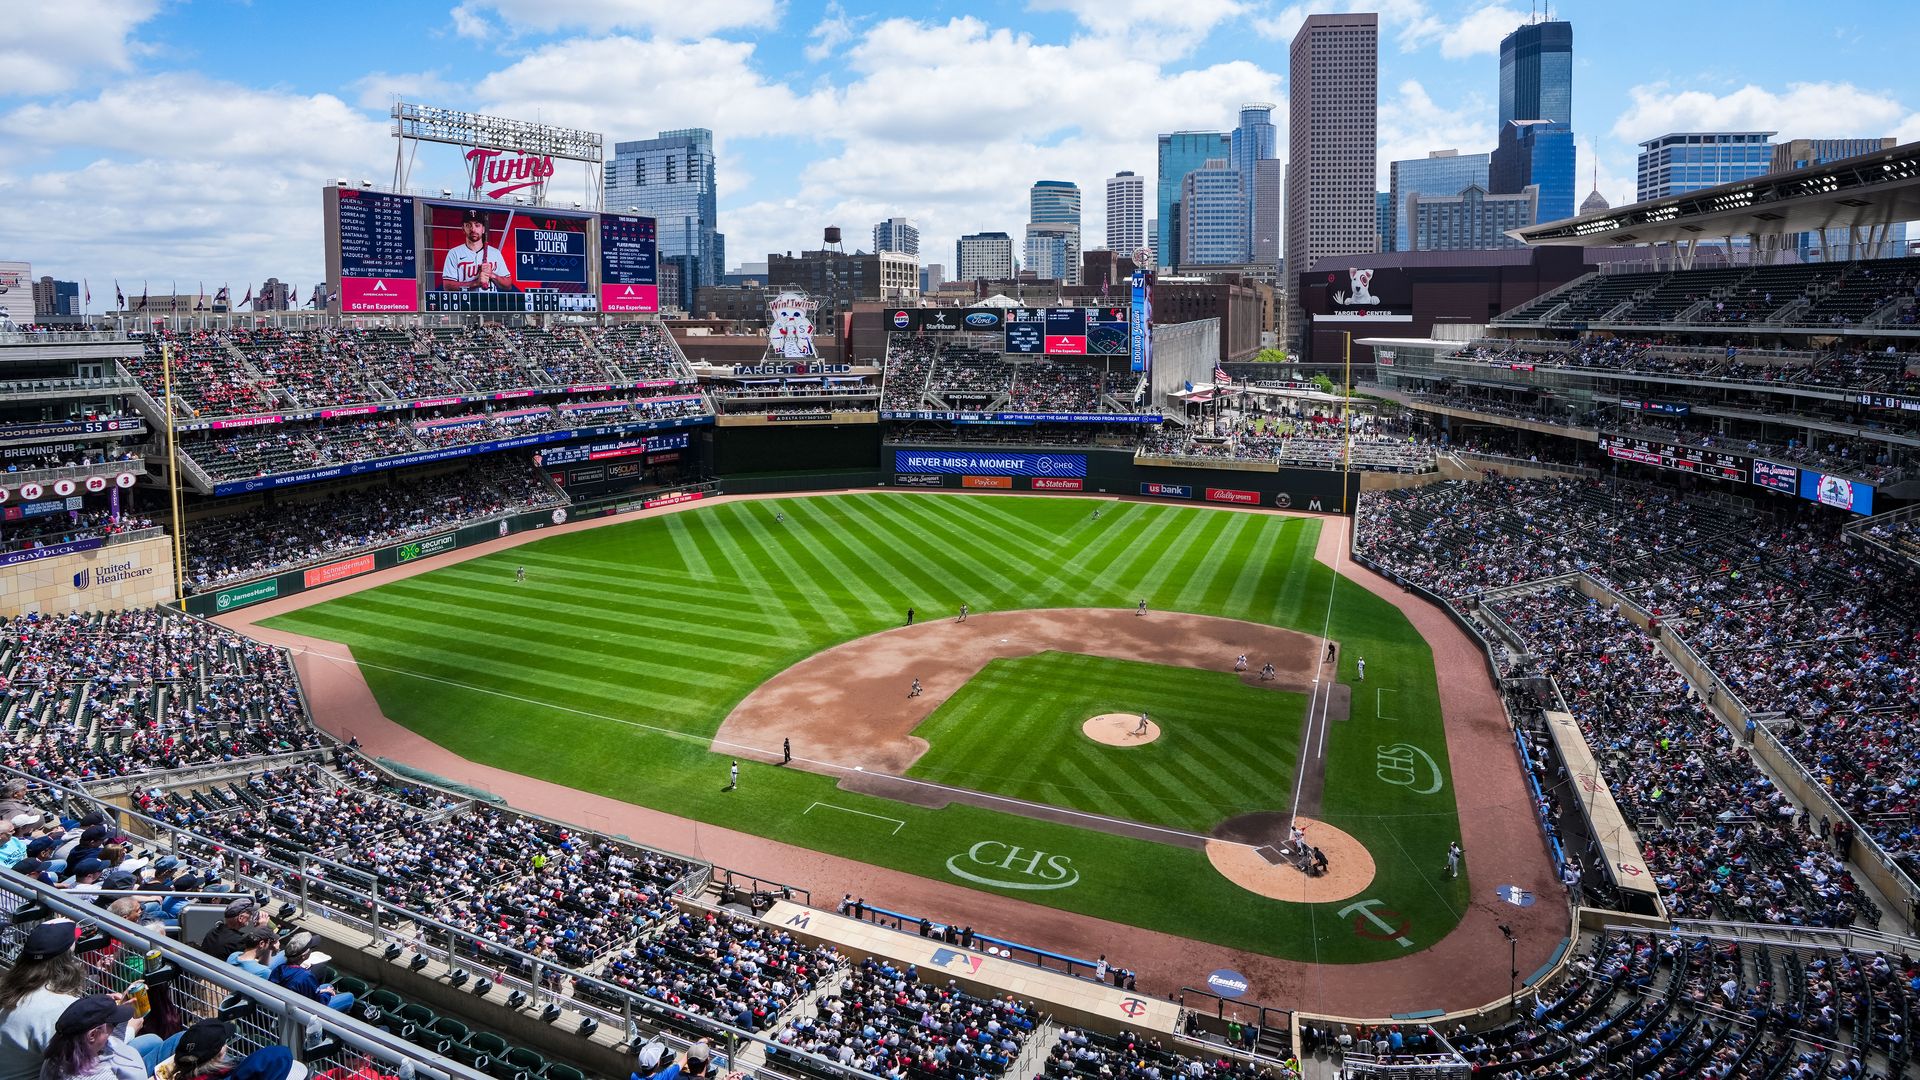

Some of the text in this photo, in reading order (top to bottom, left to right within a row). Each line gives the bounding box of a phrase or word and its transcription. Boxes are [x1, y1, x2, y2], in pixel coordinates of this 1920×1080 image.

[466, 149, 554, 189] Twins
[545, 220, 556, 230] 47
[534, 232, 568, 241] EDOUARD
[535, 241, 567, 253] JULIEN
[522, 254, 534, 264] 0-1
[1132, 278, 1143, 287] 47
[770, 299, 818, 310] Win! Twins!
[736, 364, 851, 374] TARGET FIELD
[221, 419, 252, 428] Treasure
[4, 443, 74, 458] BREWING PUB
[1632, 451, 1644, 460] Home
[1645, 454, 1658, 462] Games
[908, 458, 1025, 468] NEVER MISS A MOMENT
[317, 469, 340, 478] MOMENT
[618, 464, 638, 474] SOLAR
[1755, 463, 1794, 476] Sota Summers
[90, 480, 102, 488] 29
[26, 488, 37, 496] 14
[1214, 490, 1235, 501] Bally
[422, 537, 452, 549] securian
[8, 546, 74, 562] GRAY DUCK
[422, 545, 444, 553] FINANCIAL
[96, 561, 131, 576] United
[323, 559, 370, 575] Schneiderman's
[96, 568, 152, 585] Healthcare
[232, 586, 275, 601] JamesHardie
[1376, 744, 1416, 786] CHS
[969, 840, 1072, 880] CHS
[786, 914, 810, 929] M
[1208, 975, 1247, 990] Franklin
